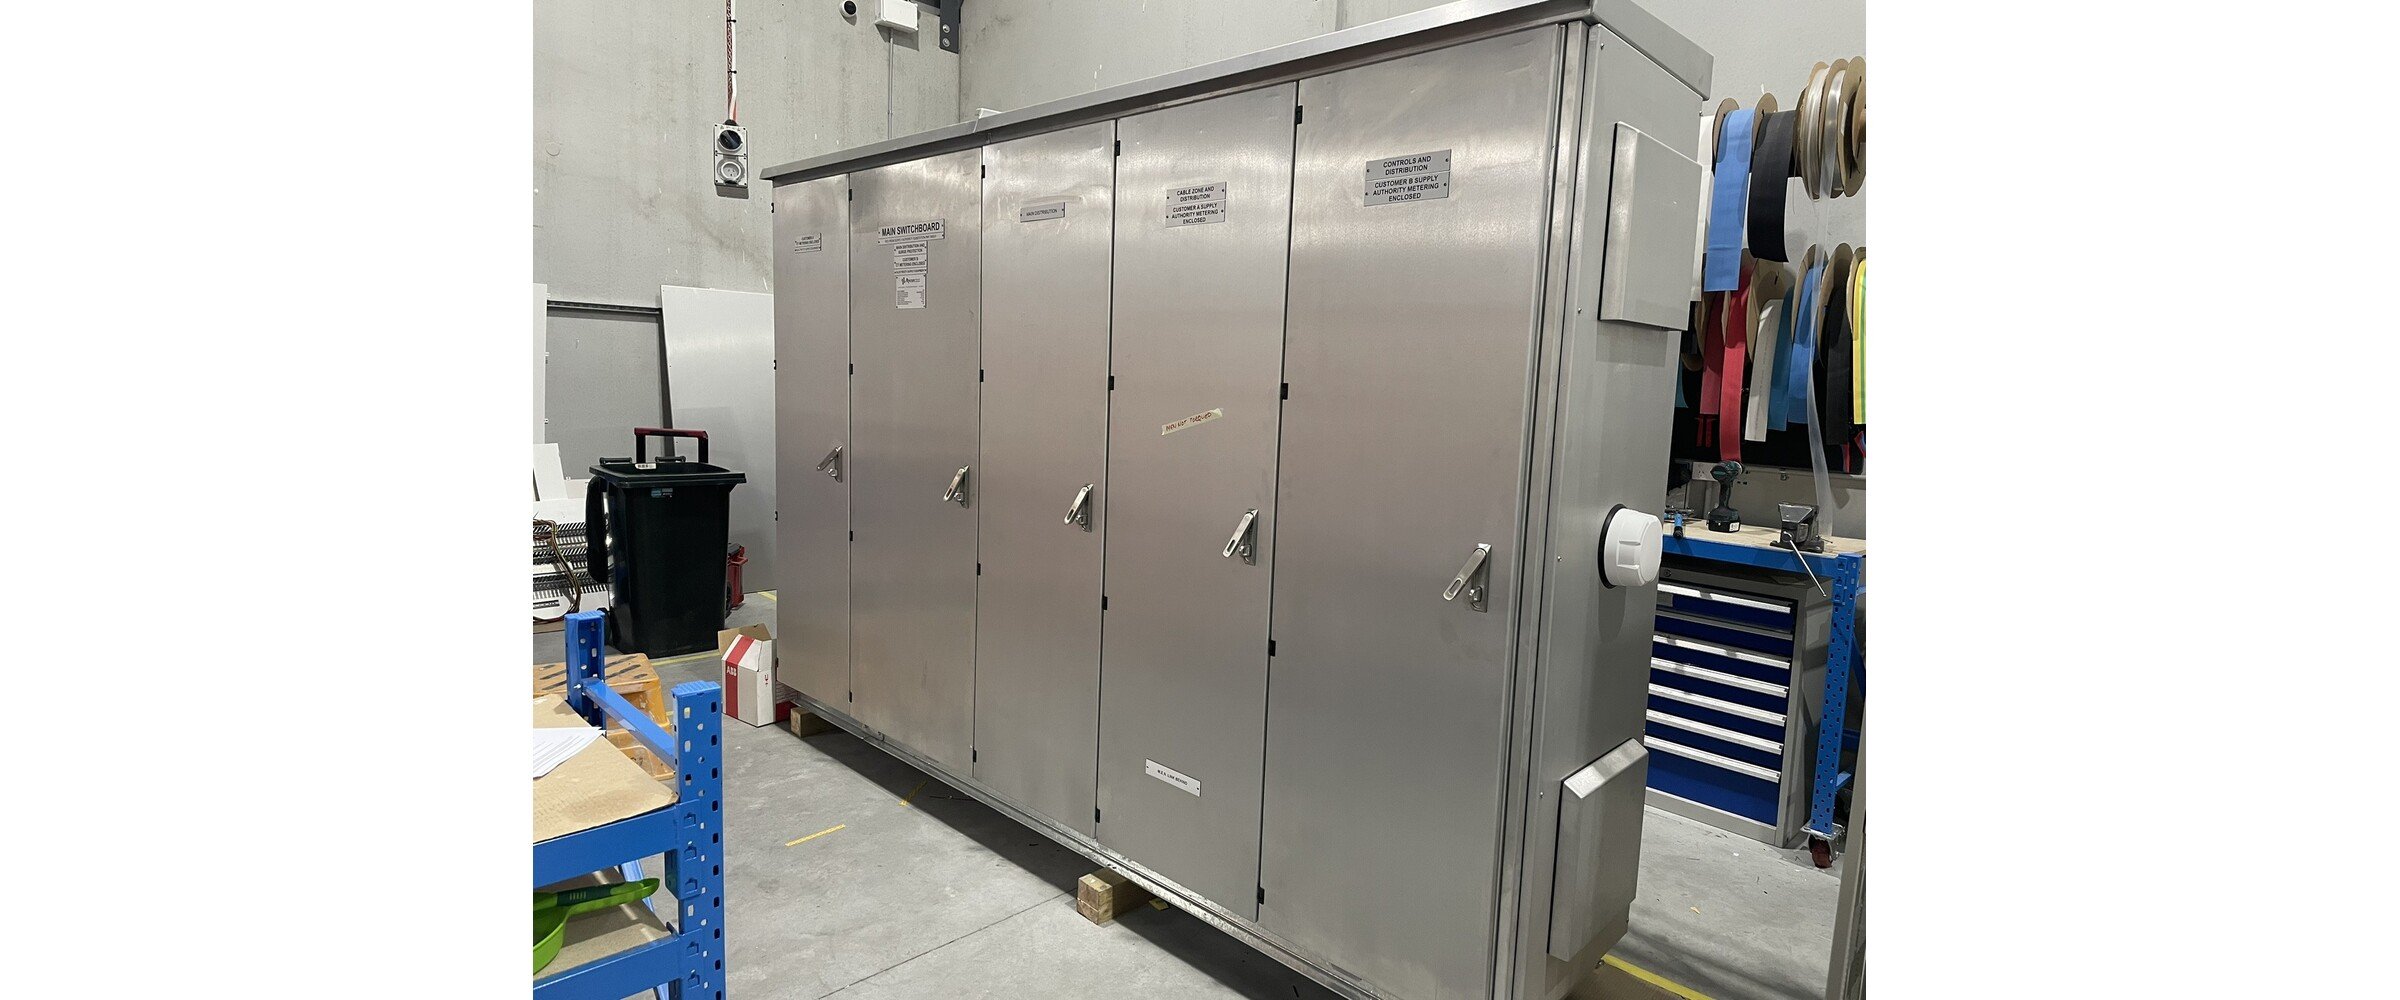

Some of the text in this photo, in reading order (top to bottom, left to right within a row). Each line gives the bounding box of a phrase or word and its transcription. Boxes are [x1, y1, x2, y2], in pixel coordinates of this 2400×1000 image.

[1383, 155, 1432, 168] CONTROLS AND
[1385, 164, 1428, 176] DISTRIBUTION
[1375, 179, 1408, 189] CUSTOMER
[1414, 175, 1439, 184] SUPPLY
[1372, 182, 1439, 196] AUTHORITY METERING
[1180, 193, 1210, 202] DISTRIBUTION
[1388, 192, 1422, 202] ENCLOSED
[1171, 209, 1218, 219] AUTHORITY METERING
[1172, 205, 1196, 213] CUSTOMER
[881, 222, 940, 236] MAIN SWITCHBOARD
[726, 665, 737, 677] ABB
